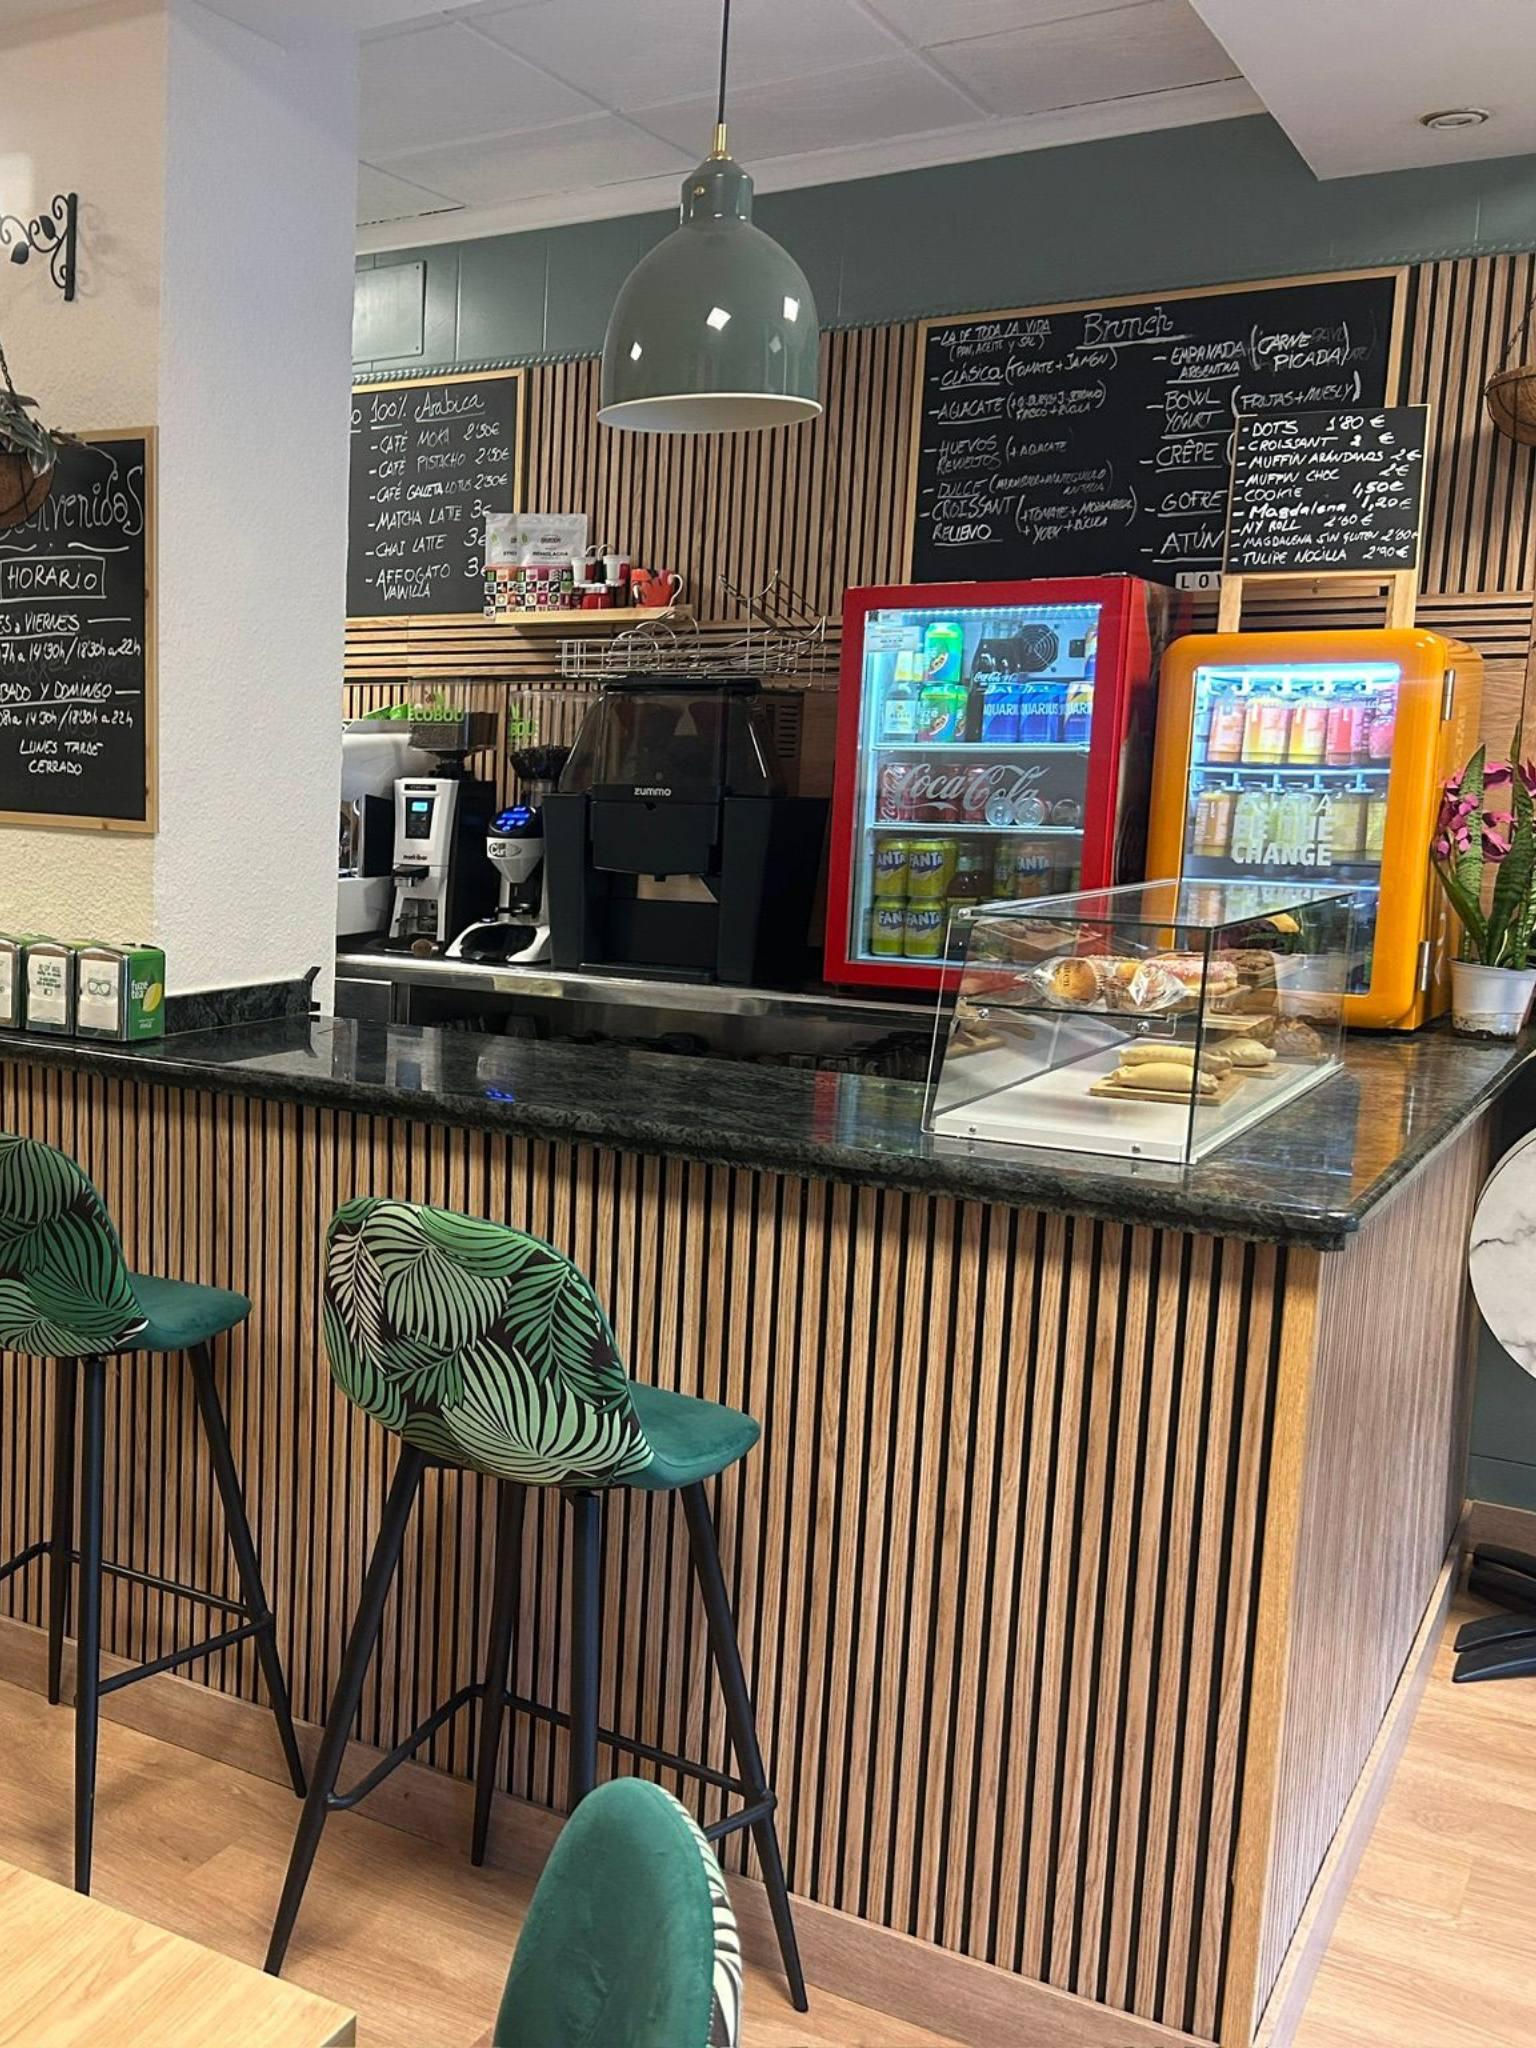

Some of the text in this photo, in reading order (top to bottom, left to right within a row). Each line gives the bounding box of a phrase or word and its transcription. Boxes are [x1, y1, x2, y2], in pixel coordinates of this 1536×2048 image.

[1083, 306, 1174, 346] Brunch
[414, 388, 486, 420] Arabica
[1164, 386, 1222, 411] BOWL
[1252, 420, 1299, 437] DOTS
[1370, 414, 1386, 428] €
[939, 434, 998, 455] HUEVOS
[1156, 439, 1219, 467] CRÊPE
[1248, 437, 1339, 452] CROISSANT
[1378, 431, 1396, 445] €
[1305, 467, 1341, 482] CHOC
[1161, 489, 1228, 512] GOFRE
[1244, 484, 1303, 502] COOKIE
[932, 495, 1016, 522] CROISSANT
[1250, 501, 1347, 520] Magdalena
[1160, 523, 1225, 554] ATÚN
[1240, 519, 1264, 536] NY
[1268, 518, 1302, 532] ROLL
[375, 541, 406, 557] CHAI
[412, 534, 448, 553] LATTE
[1243, 535, 1312, 549] MAGDALENA
[1316, 531, 1340, 544] SIN
[376, 563, 451, 587] AFFOGATO
[25, 612, 80, 633] VIERNES
[54, 675, 113, 700] DOMINGO
[19, 738, 58, 755] LUNES
[28, 759, 83, 776] CERRADO
[634, 787, 672, 796] zummo
[1231, 842, 1332, 866] CHANGE
